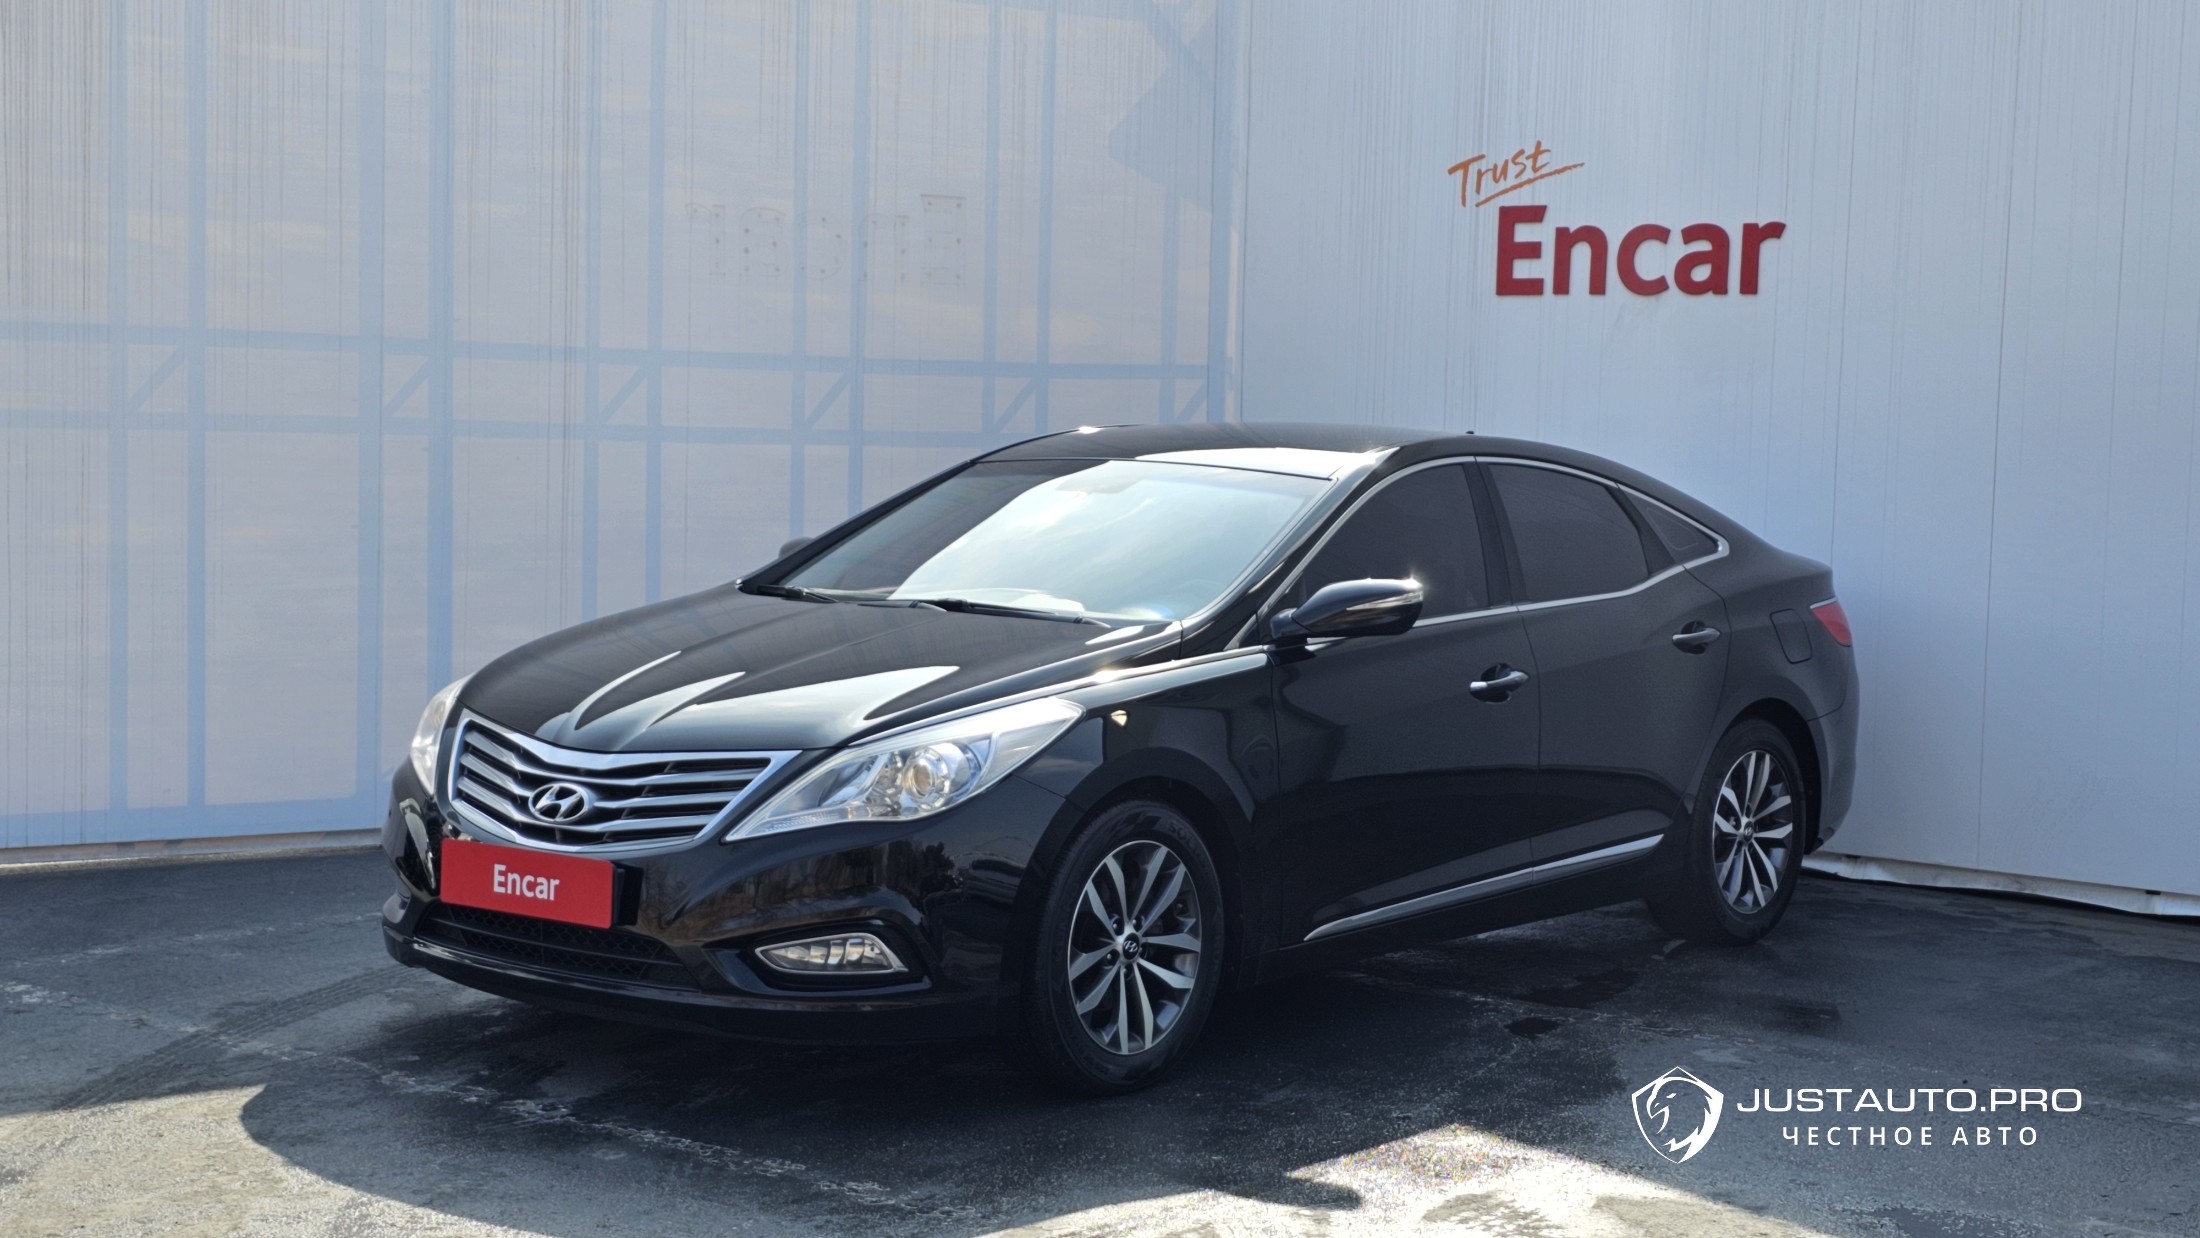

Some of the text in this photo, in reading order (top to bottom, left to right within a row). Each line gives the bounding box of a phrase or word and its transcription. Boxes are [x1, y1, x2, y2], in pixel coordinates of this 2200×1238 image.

[1447, 140, 1551, 207] Trust
[1496, 204, 1786, 296] Encar
[493, 863, 560, 901] Encar
